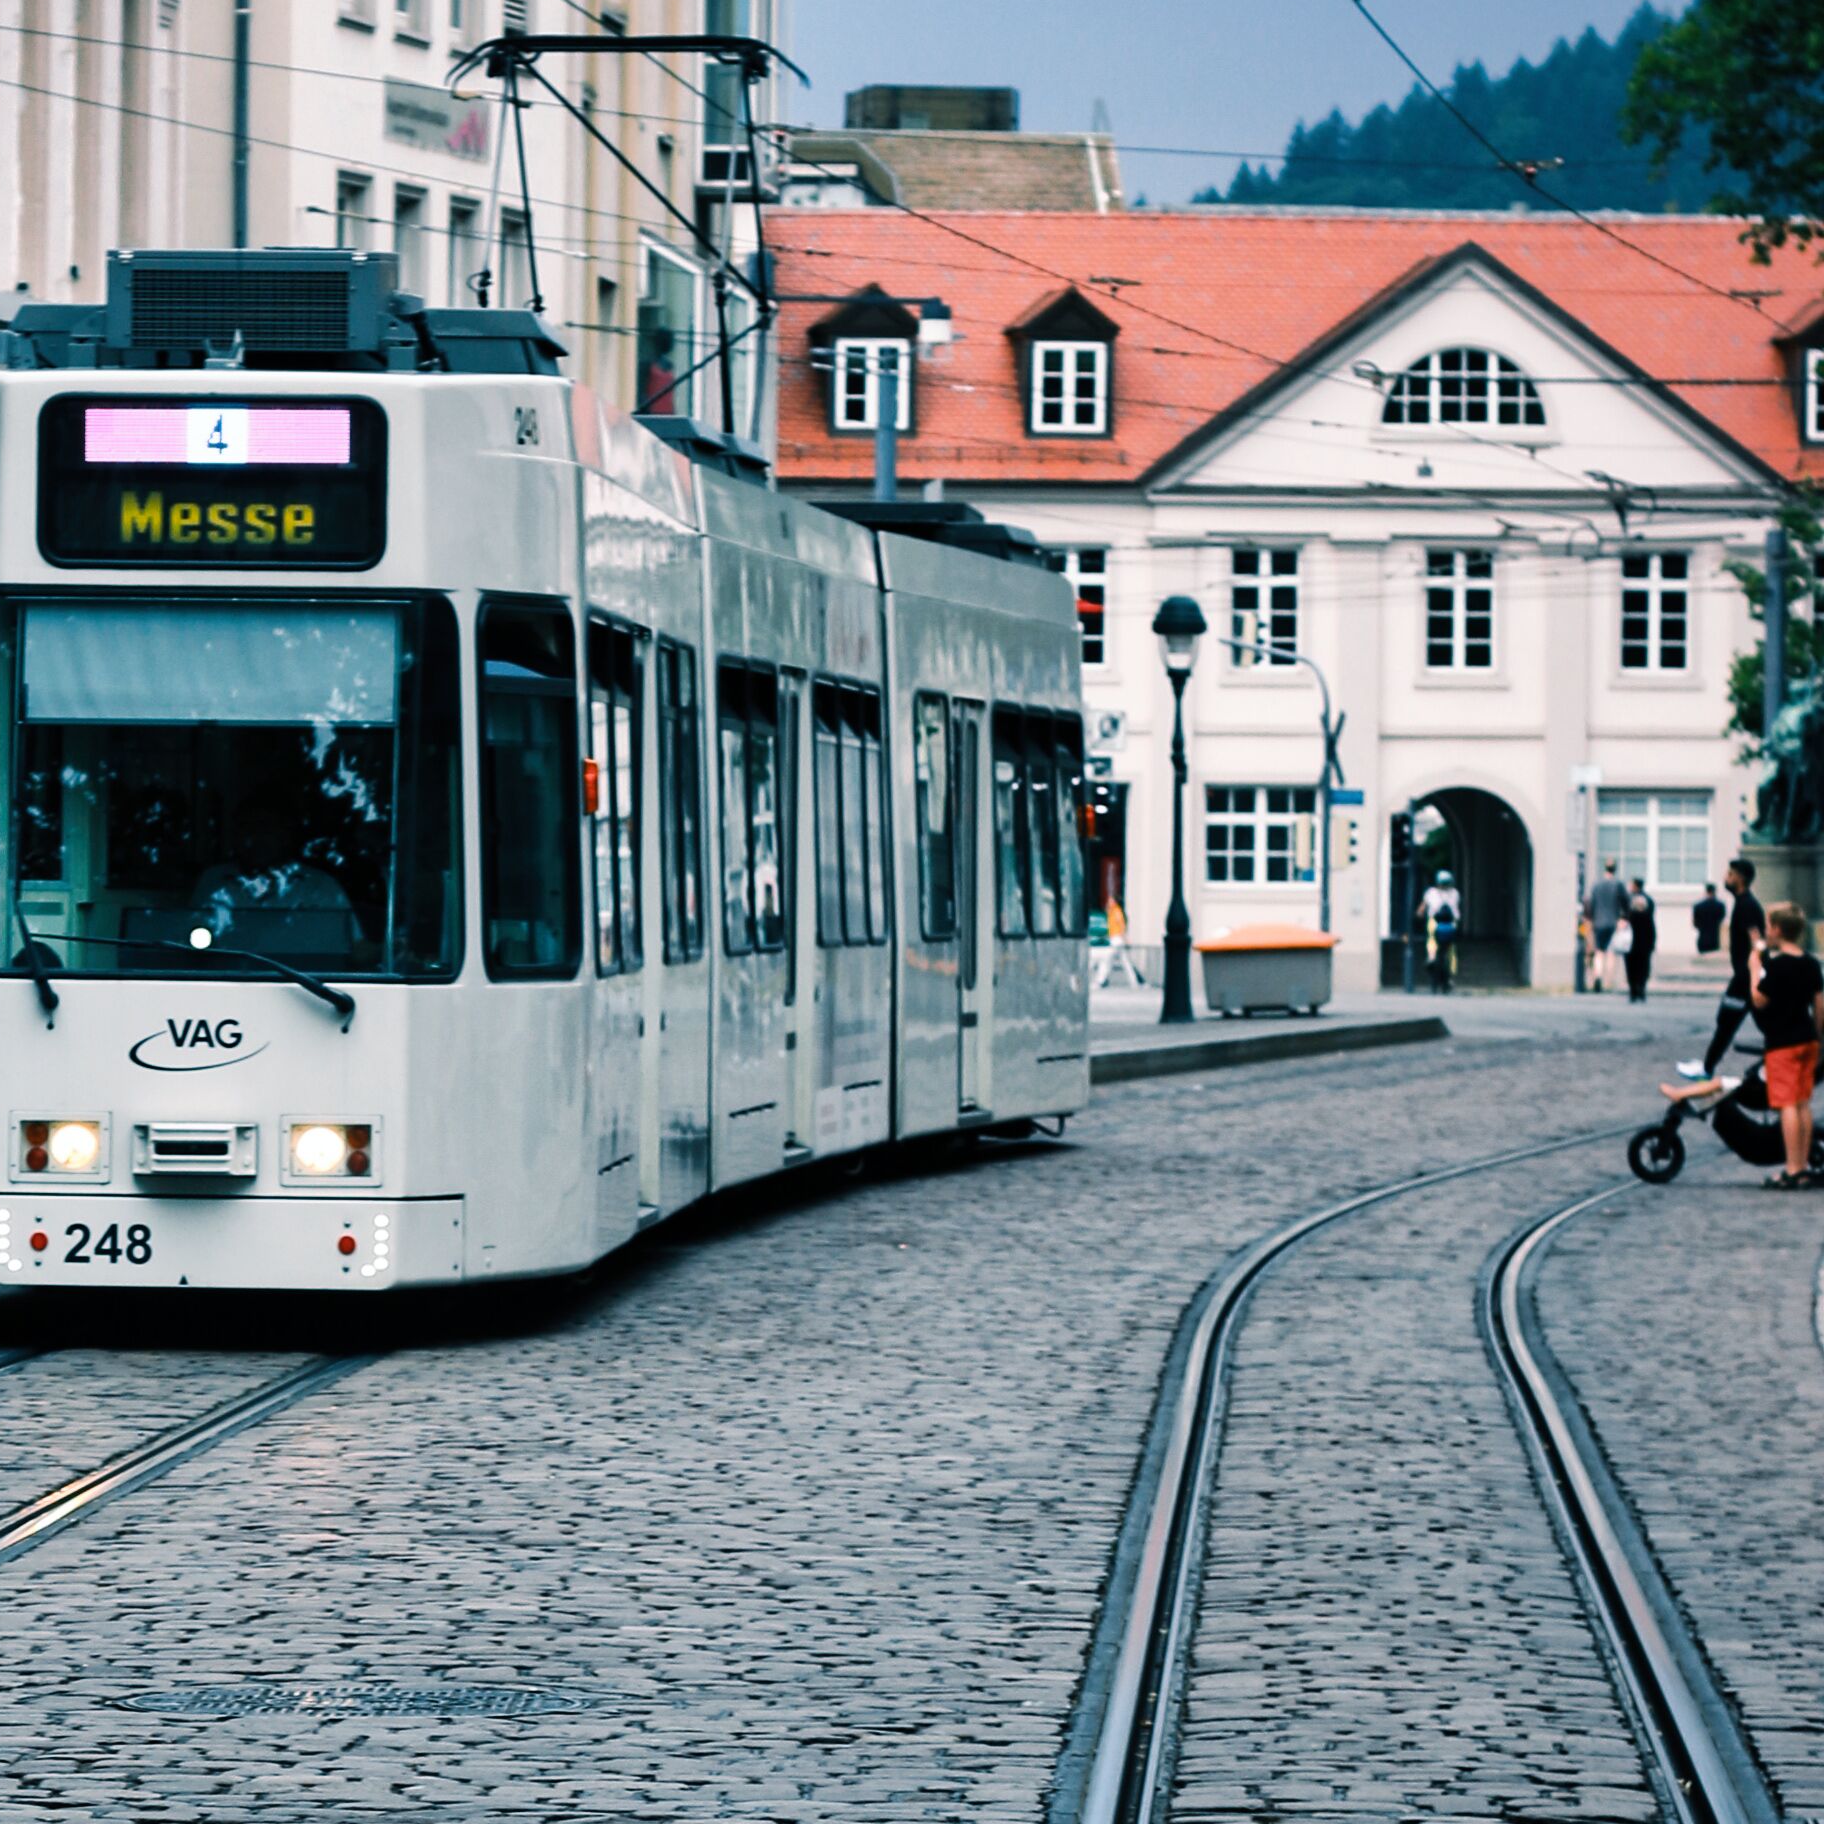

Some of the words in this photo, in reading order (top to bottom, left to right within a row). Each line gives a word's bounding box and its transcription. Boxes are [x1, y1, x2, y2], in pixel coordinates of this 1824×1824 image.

[206, 414, 229, 454] 4
[120, 491, 315, 544] Messe
[166, 1018, 243, 1049] VAG
[63, 1223, 153, 1265] 248
